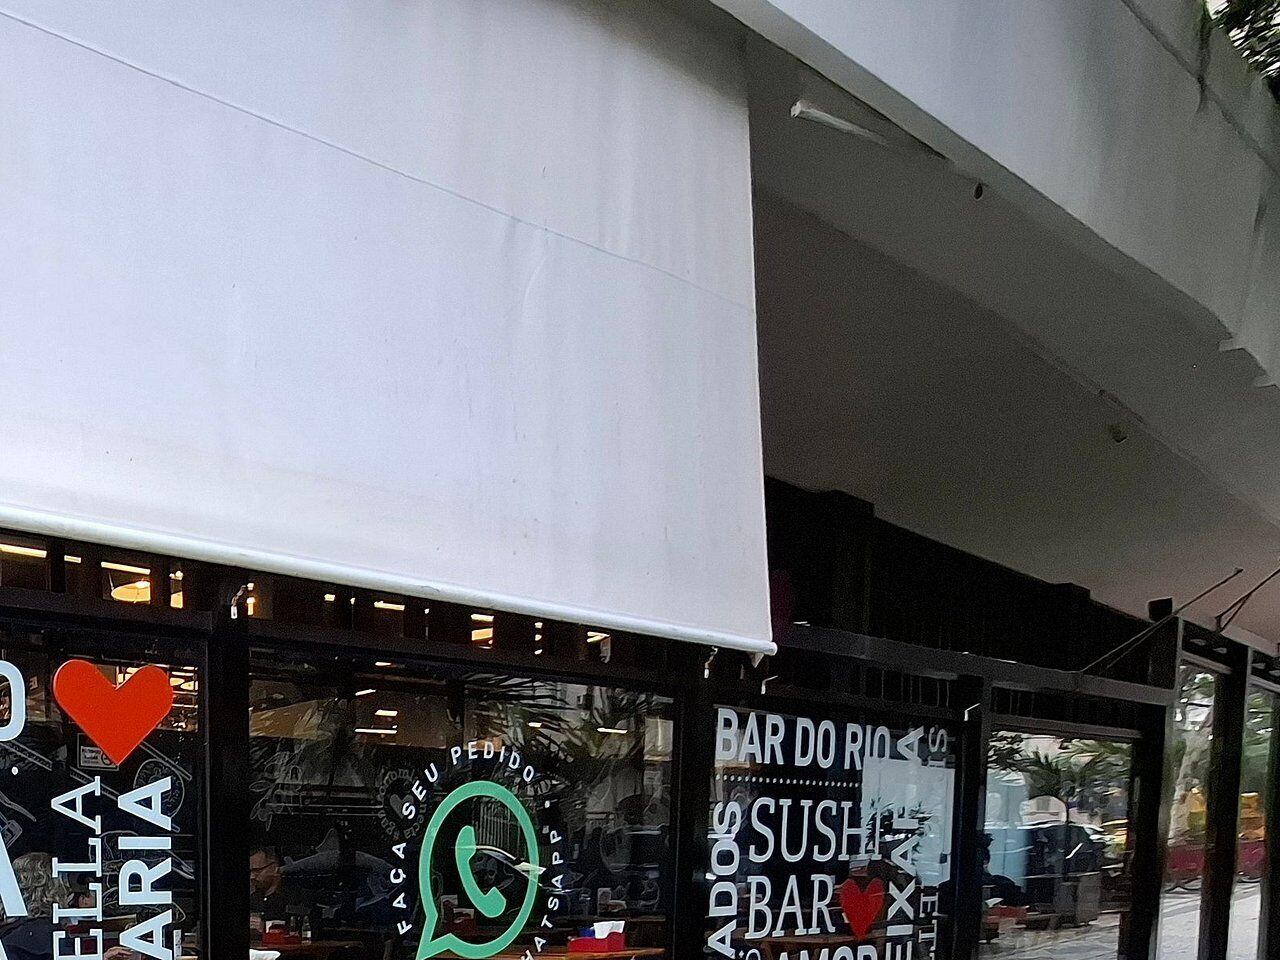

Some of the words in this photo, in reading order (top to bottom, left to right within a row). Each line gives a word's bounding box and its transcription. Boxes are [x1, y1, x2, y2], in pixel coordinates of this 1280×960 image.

[715, 708, 786, 765] BAR
[794, 717, 837, 769] DO
[844, 723, 891, 770] RIO
[389, 842, 413, 936] FAÇA
[401, 762, 439, 820] SEU
[451, 741, 535, 783] PEDIDO
[748, 797, 882, 863] SUSHI
[745, 874, 836, 940] BAR
